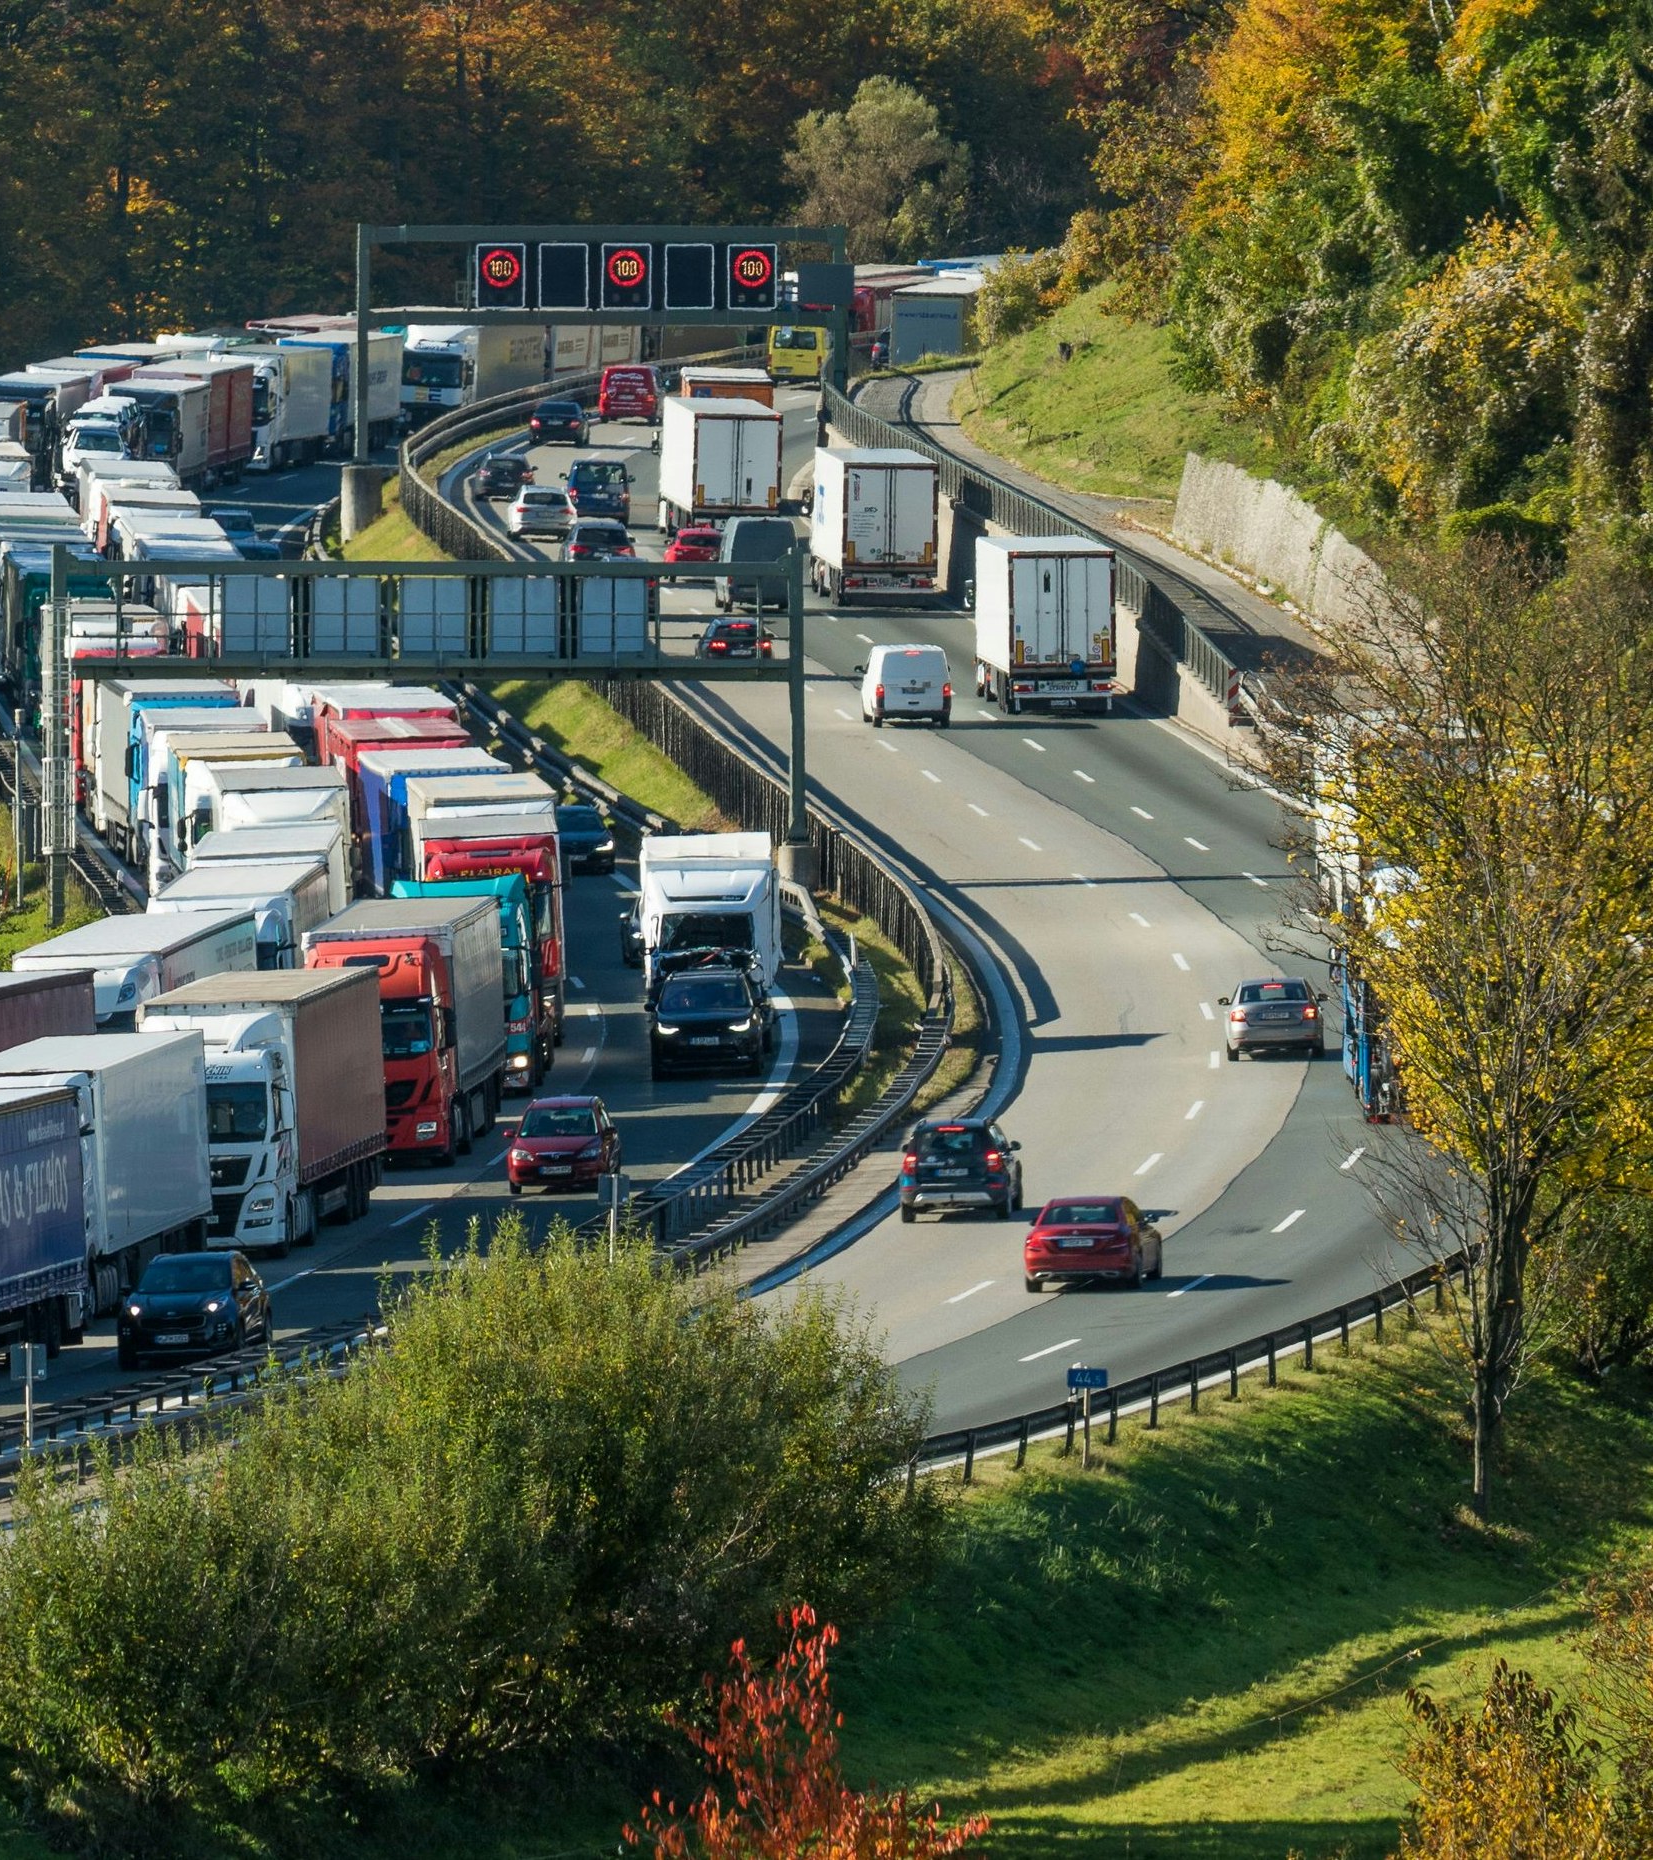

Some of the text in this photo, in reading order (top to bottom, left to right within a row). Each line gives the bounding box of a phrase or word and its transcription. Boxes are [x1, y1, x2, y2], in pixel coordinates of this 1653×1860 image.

[489, 260, 512, 277] 100
[615, 260, 637, 277] 100
[741, 260, 763, 277] 100
[13, 1164, 26, 1219] &
